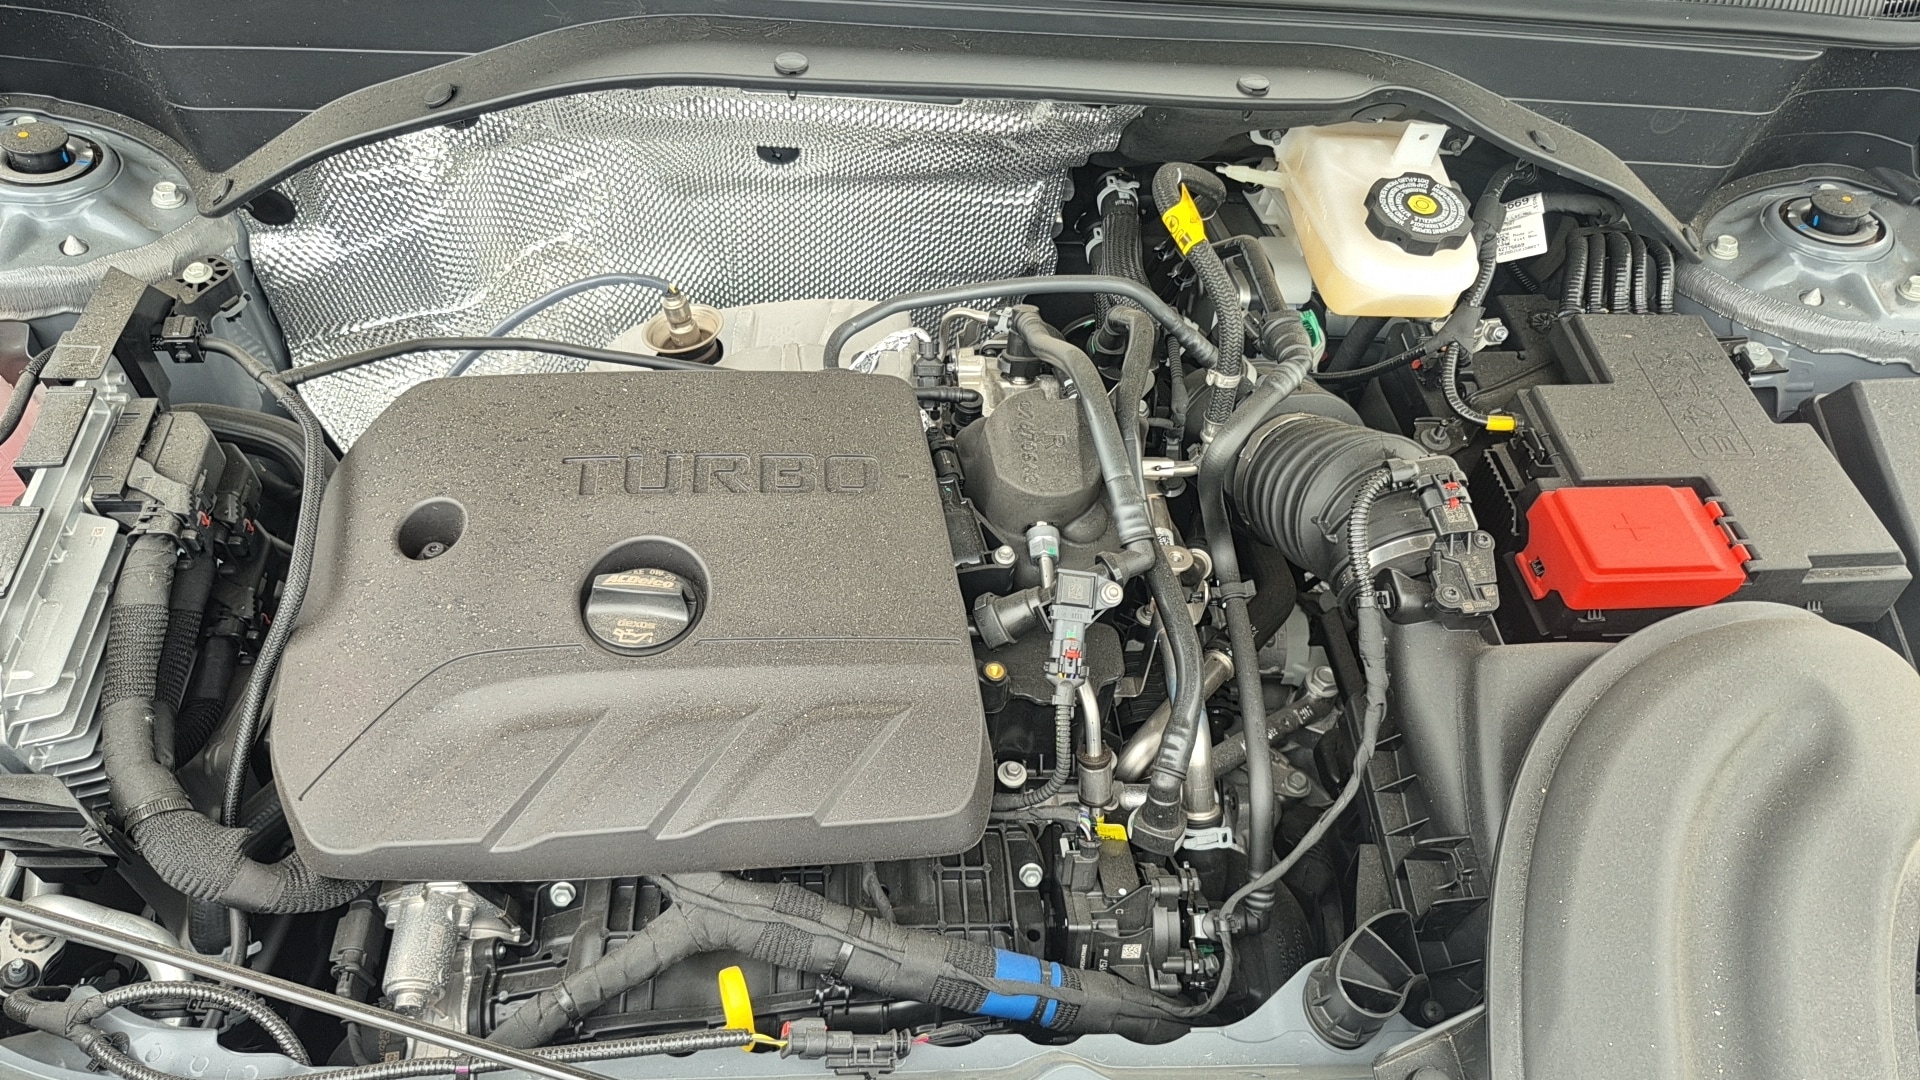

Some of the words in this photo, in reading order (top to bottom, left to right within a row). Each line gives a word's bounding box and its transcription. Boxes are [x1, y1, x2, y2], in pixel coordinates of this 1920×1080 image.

[1504, 198, 1529, 210] 669
[562, 453, 881, 496] TURBO
[602, 574, 675, 588] ACDelco
[617, 619, 657, 630] dexos
